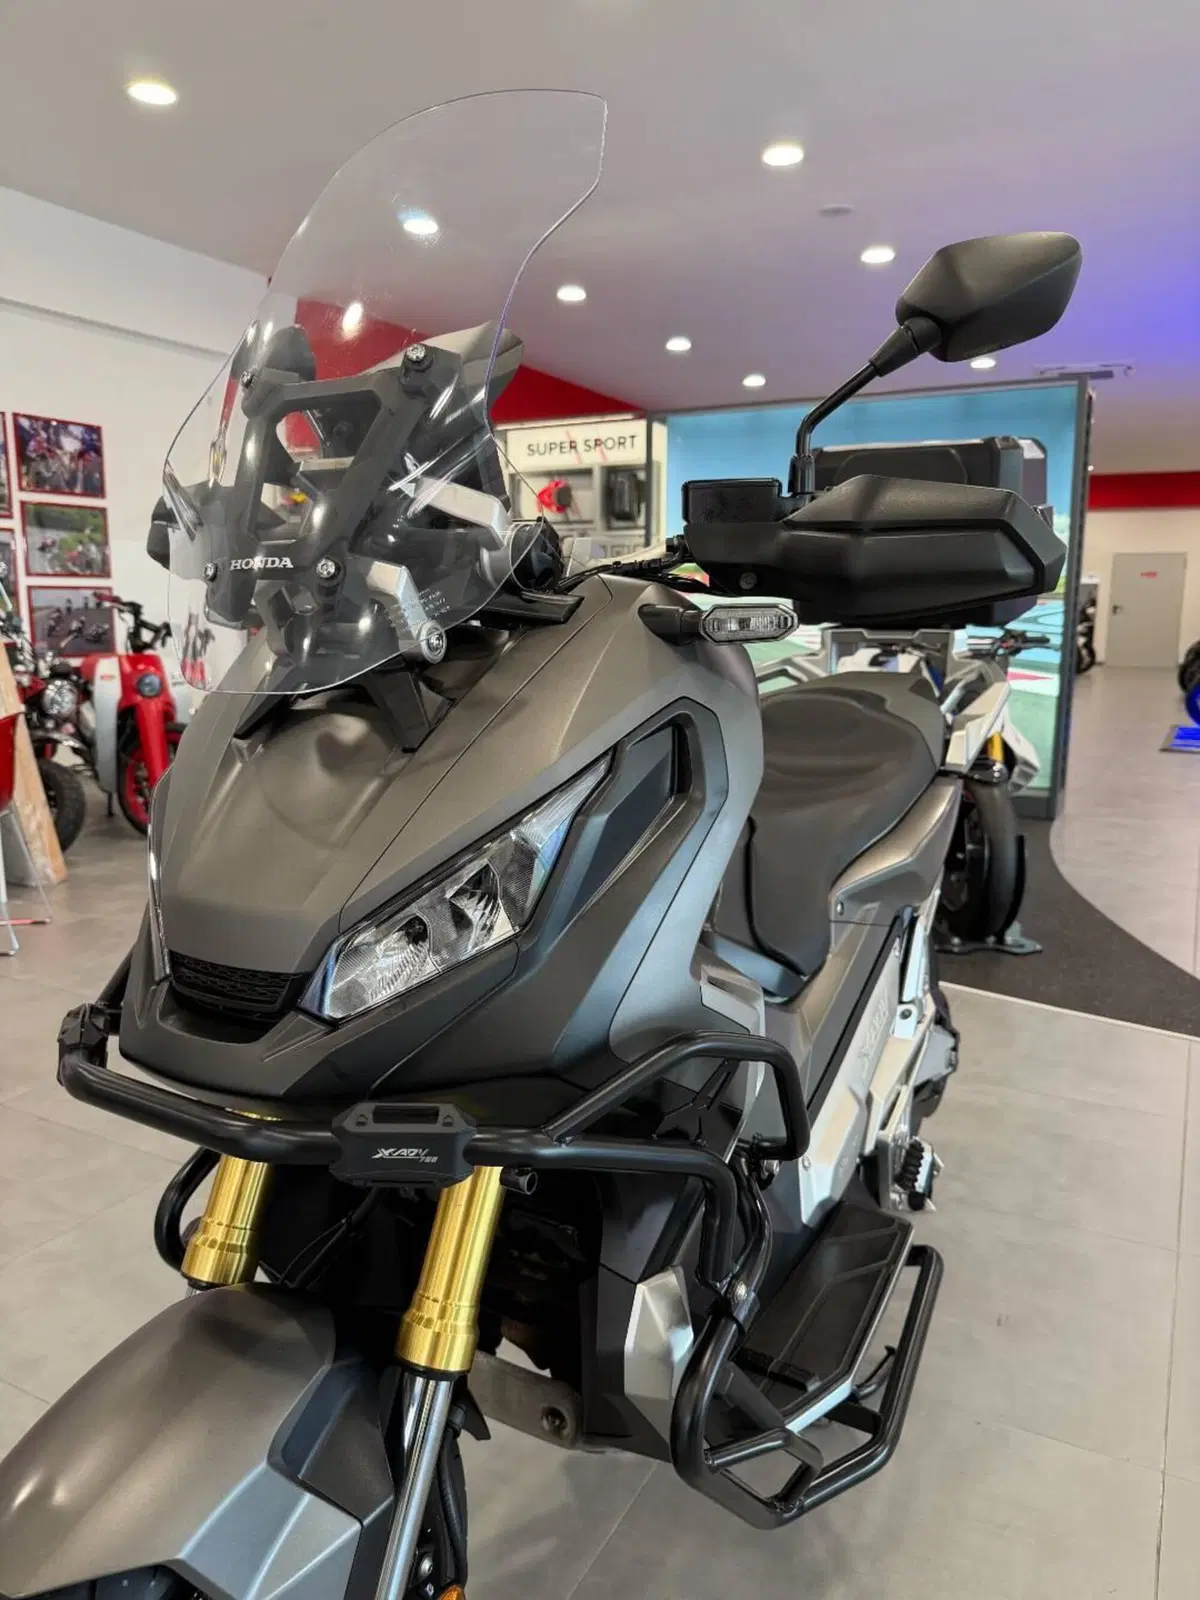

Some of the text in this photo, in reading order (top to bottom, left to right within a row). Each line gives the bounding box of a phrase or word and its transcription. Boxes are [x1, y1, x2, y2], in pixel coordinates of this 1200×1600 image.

[526, 435, 638, 457] SUPER SPORT
[230, 556, 294, 571] HONDA
